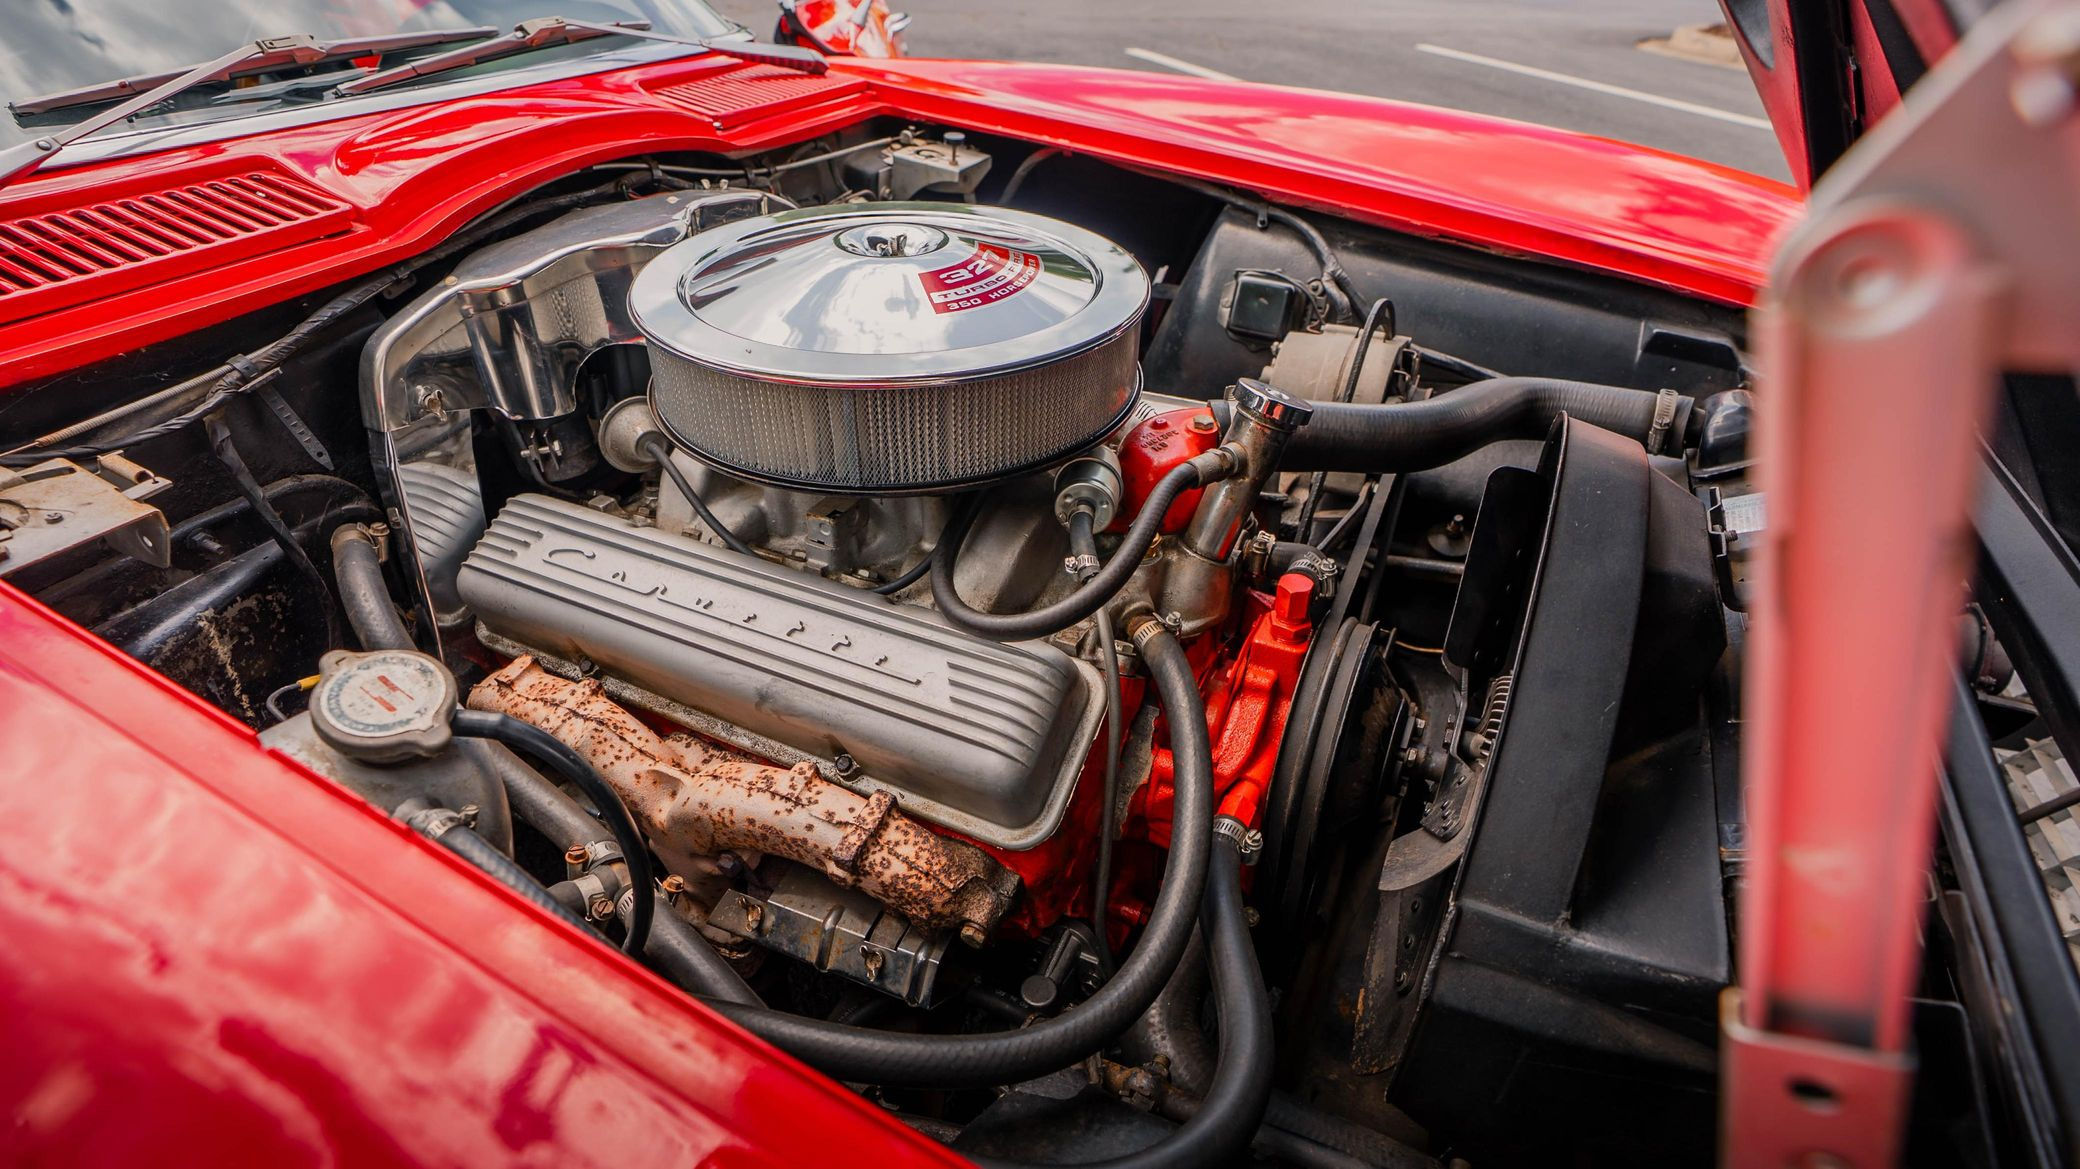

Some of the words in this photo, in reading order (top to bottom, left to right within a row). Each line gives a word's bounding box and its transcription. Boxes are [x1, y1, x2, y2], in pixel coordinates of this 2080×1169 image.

[938, 249, 1000, 284] 327
[947, 297, 982, 311] 350
[988, 257, 1037, 300] HORSEPOWER
